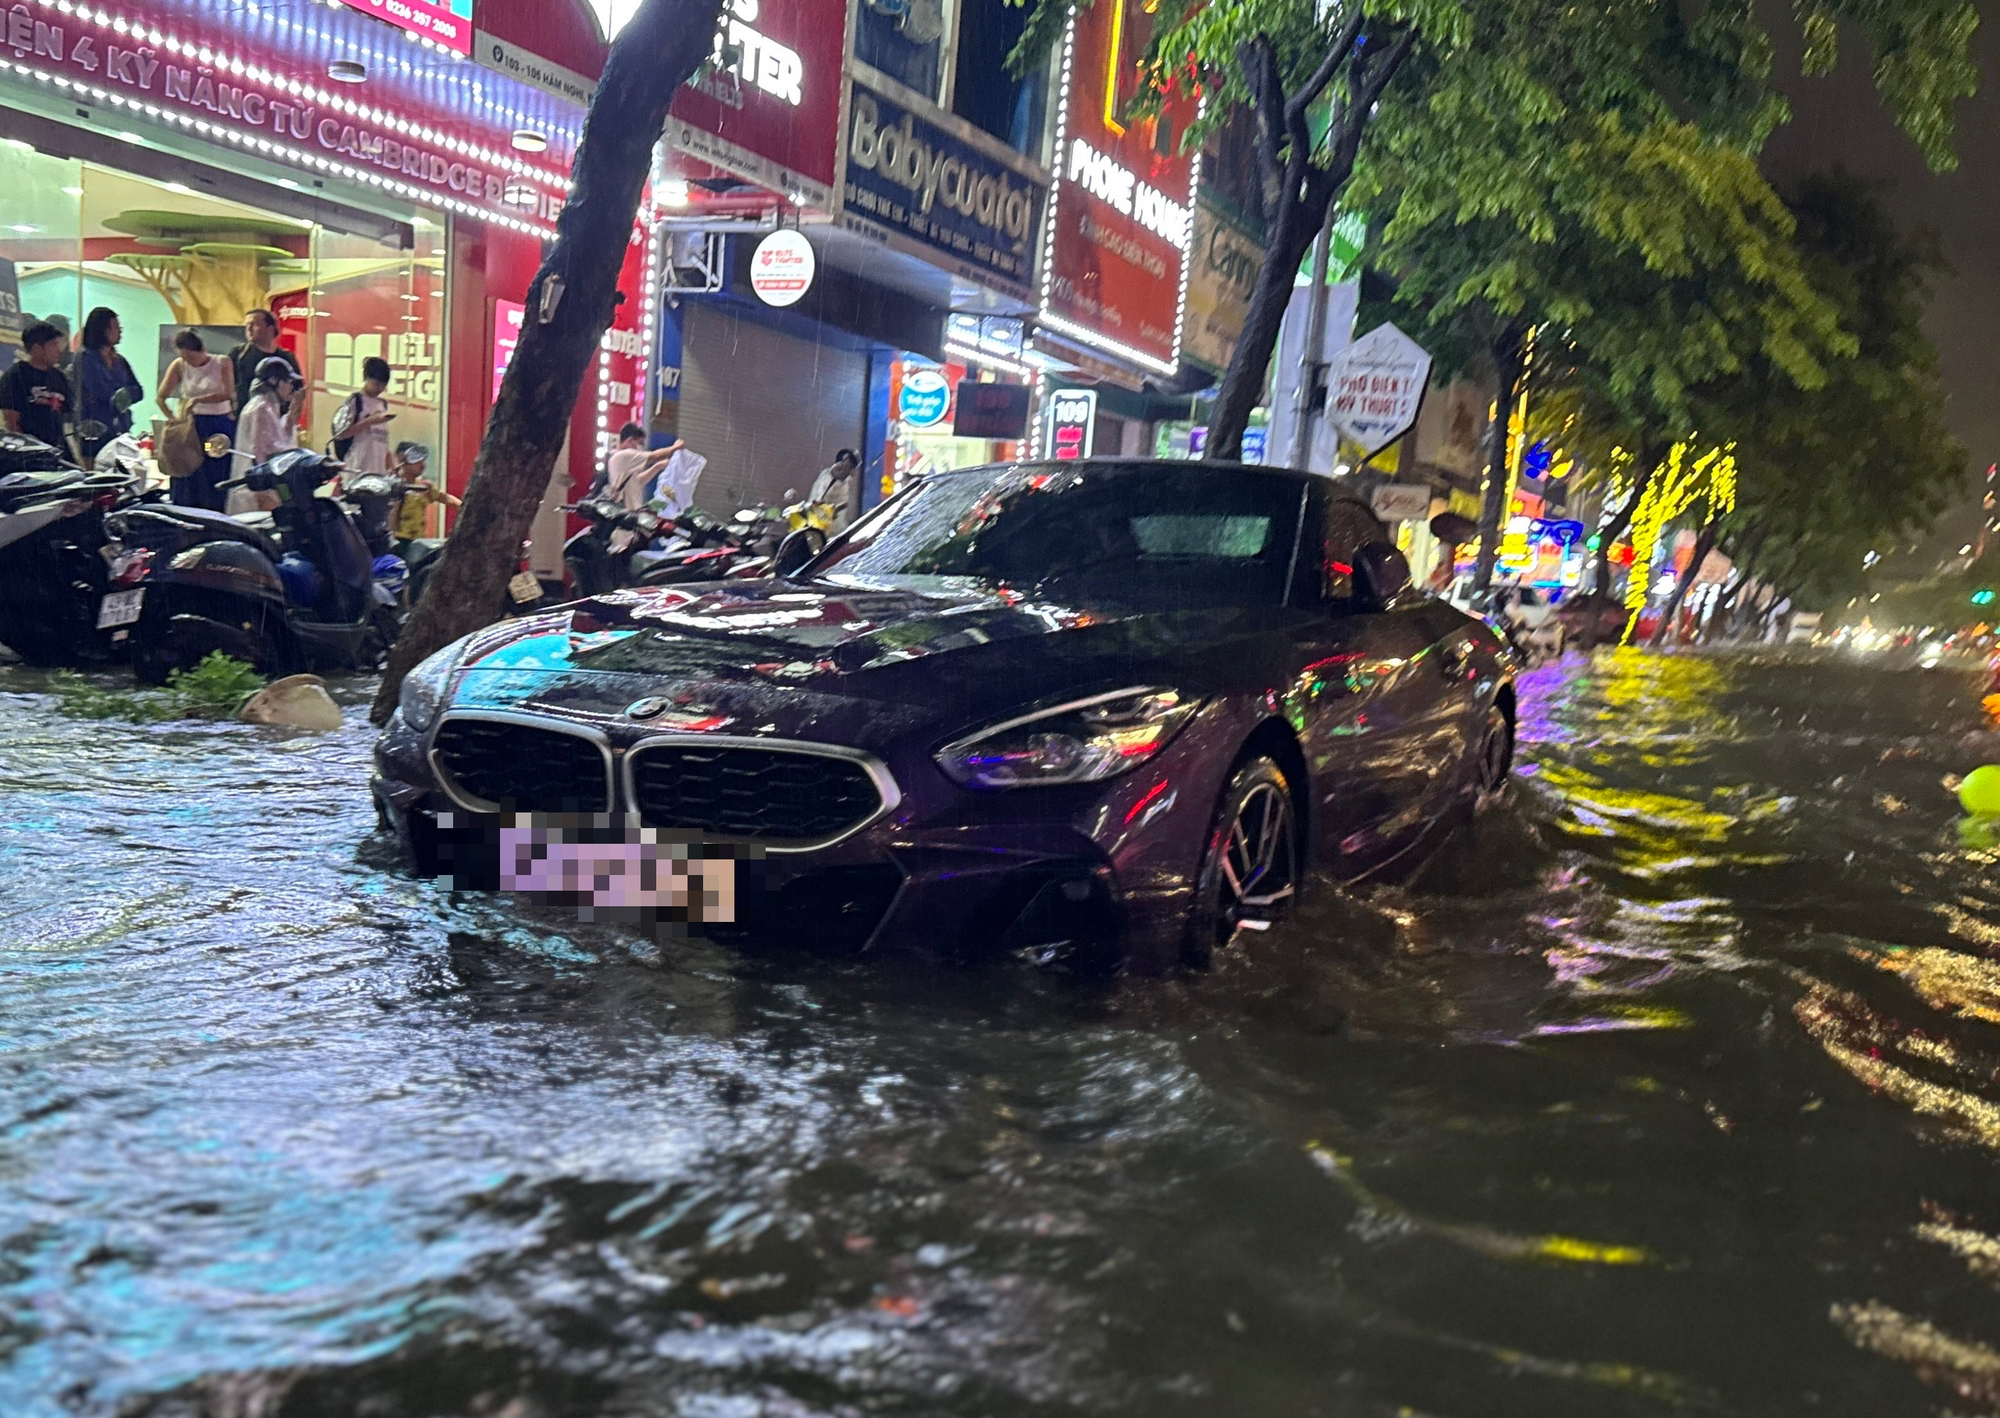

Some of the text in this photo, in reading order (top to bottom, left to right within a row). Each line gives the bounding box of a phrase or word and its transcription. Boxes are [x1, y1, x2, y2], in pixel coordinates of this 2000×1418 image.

[71, 36, 99, 71] 4
[107, 46, 159, 89] KỸ
[165, 66, 265, 125] NĂNG
[318, 118, 482, 198] CAMBRIDGE
[1070, 138, 1189, 249] PHONE HOUSE
[1055, 401, 1088, 422] 109
